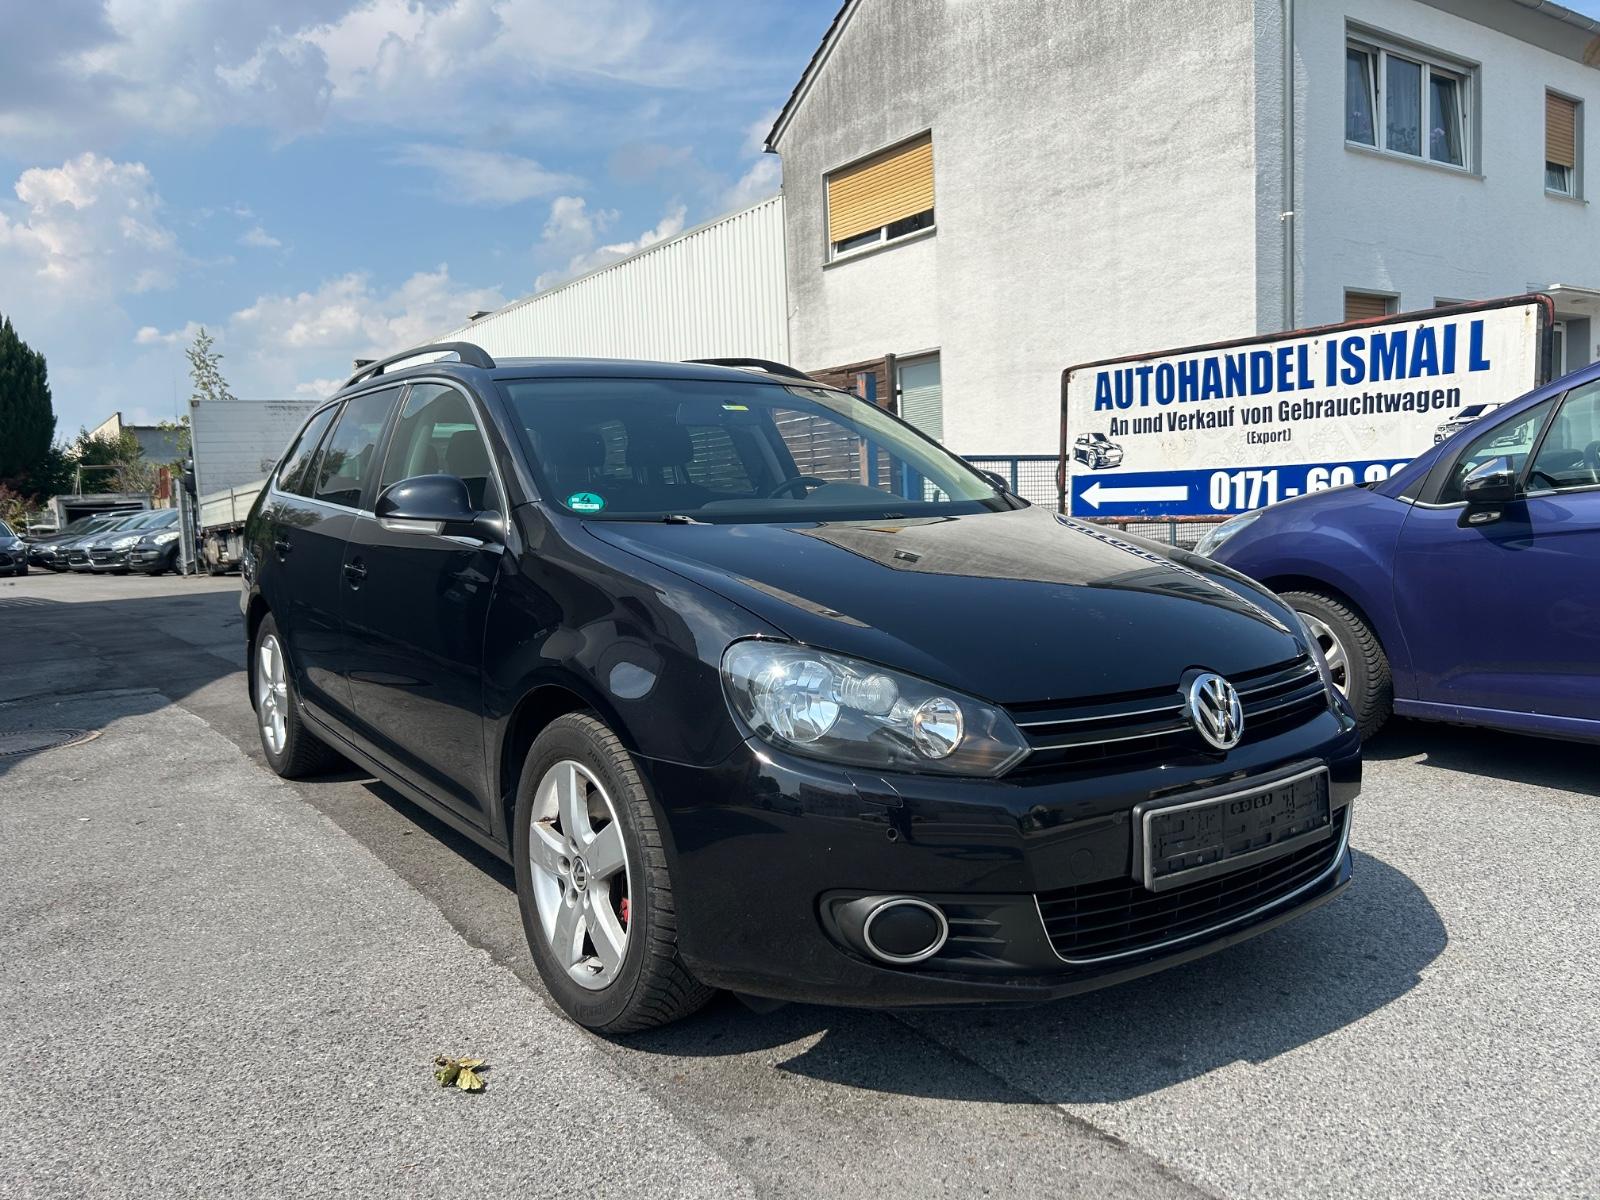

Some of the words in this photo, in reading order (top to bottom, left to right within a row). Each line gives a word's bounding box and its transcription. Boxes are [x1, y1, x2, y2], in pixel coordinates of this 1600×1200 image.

[1094, 344, 1315, 412] AUTOHANDEL
[1109, 417, 1128, 436] An
[1132, 413, 1163, 434] und
[1167, 406, 1235, 432] Verkauf
[1240, 405, 1273, 425] von
[1278, 387, 1461, 422] Gebrauchtwagen
[1246, 428, 1292, 445] (Export)
[580, 494, 591, 503] 4
